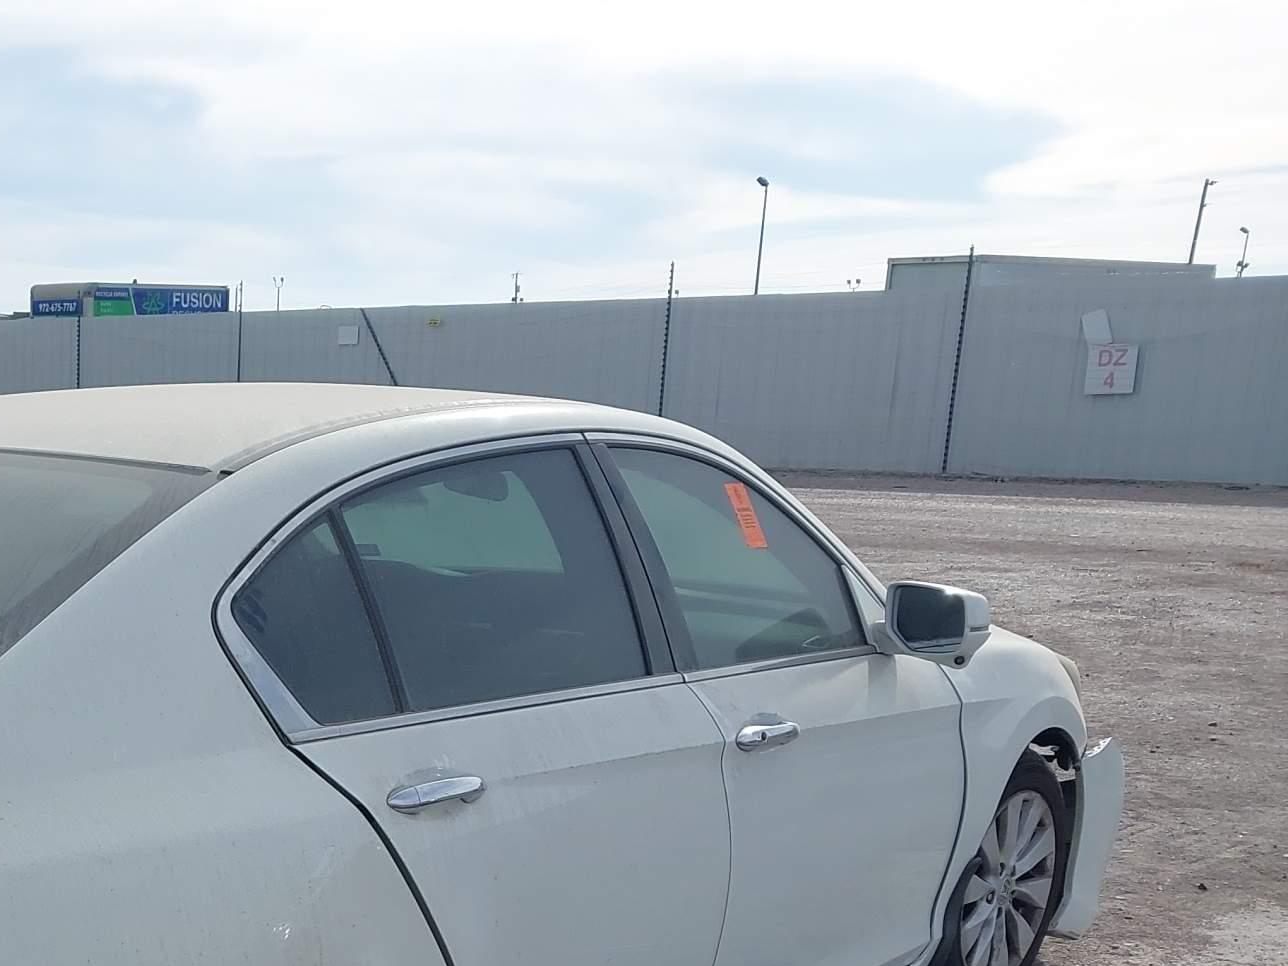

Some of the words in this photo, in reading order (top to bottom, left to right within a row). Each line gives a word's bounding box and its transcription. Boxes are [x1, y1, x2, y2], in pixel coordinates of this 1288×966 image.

[172, 292, 222, 308] FUSION
[1098, 348, 1129, 367] DZ
[1103, 371, 1114, 389] 4
